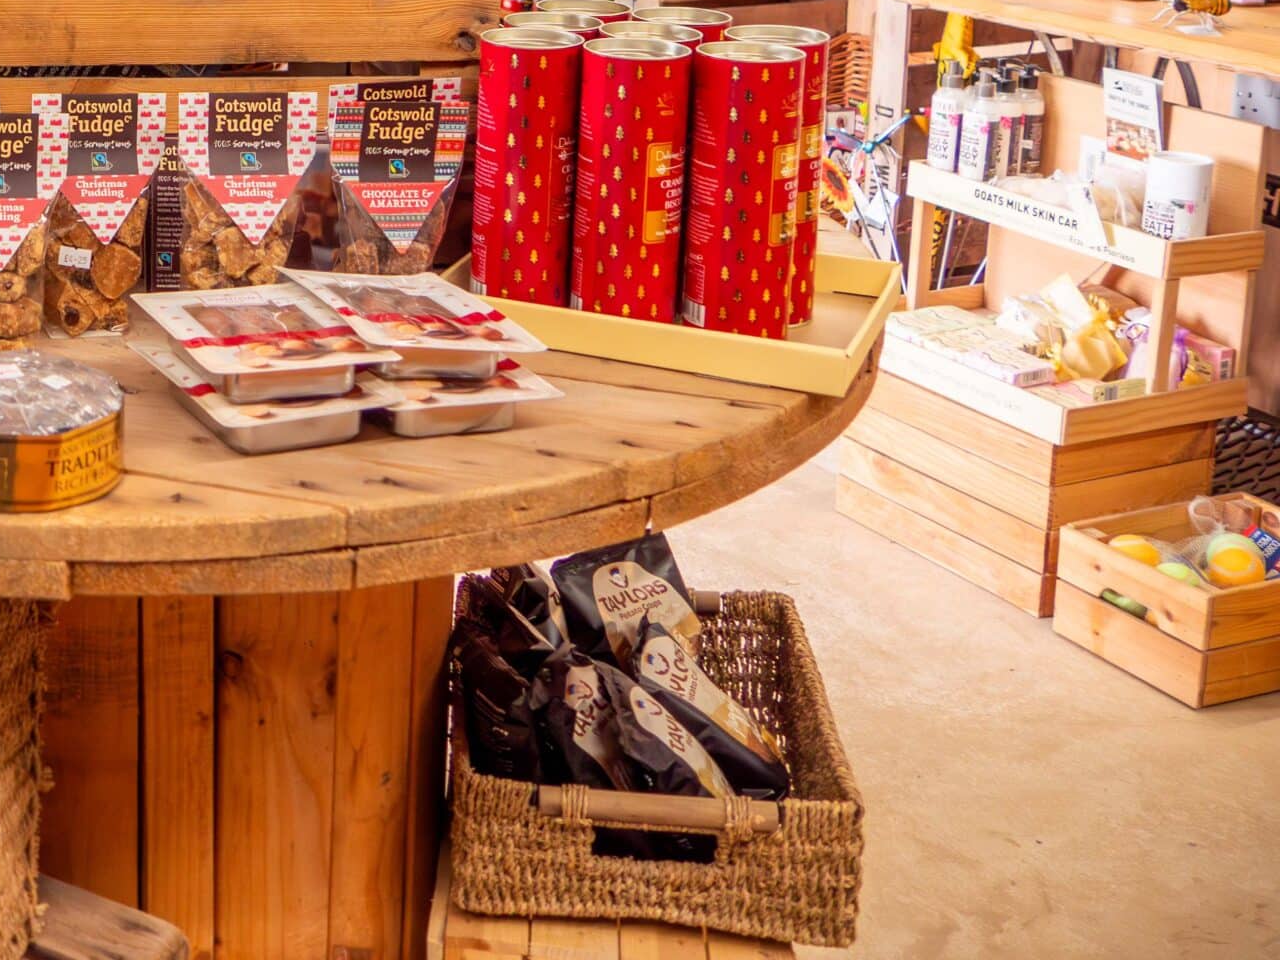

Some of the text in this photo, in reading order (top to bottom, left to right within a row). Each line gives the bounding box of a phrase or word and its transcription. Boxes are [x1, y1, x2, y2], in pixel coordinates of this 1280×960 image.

[363, 85, 427, 100] Cotswold
[67, 98, 132, 114] Cotswold
[215, 98, 282, 113] Cotswold
[370, 107, 434, 121] Cotswold
[215, 114, 274, 136] Fudge
[368, 122, 425, 144] Fudge
[75, 180, 127, 190] Christmas
[224, 178, 277, 189] Christmas
[81, 189, 124, 199] Pudding
[229, 188, 274, 199] Pudding
[362, 188, 434, 199] CHOCOLATE &
[370, 199, 428, 209] AMARETTO
[974, 189, 1078, 230] GOATS MILK SKIN CAR
[598, 579, 668, 612] TAYLORS
